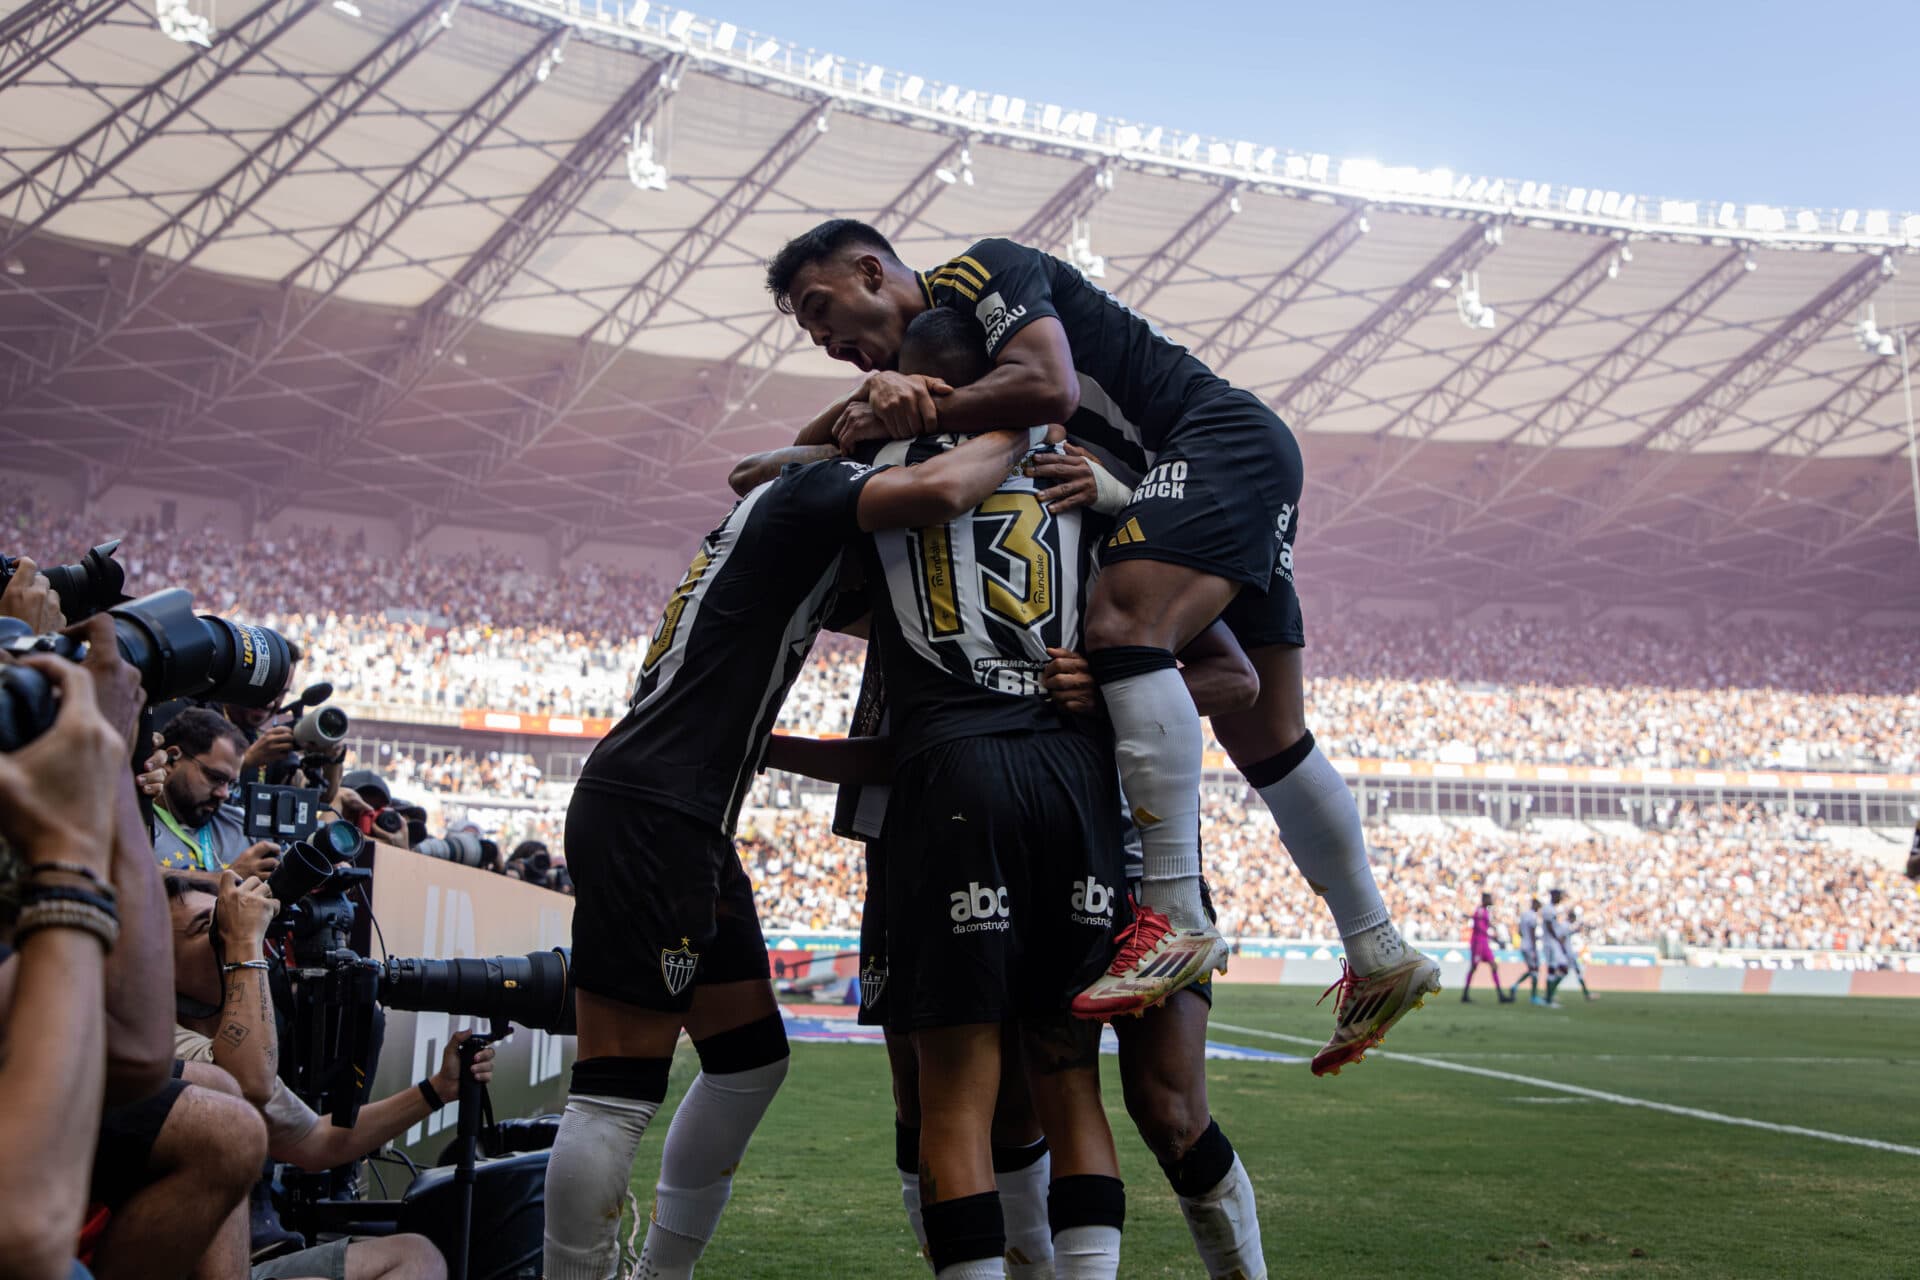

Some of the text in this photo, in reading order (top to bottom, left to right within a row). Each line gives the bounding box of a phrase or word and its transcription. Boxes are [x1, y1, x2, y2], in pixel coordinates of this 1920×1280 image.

[985, 304, 1028, 357] ERDAU
[1141, 460, 1188, 487] UTO
[1126, 481, 1186, 506] RUCK
[1033, 554, 1046, 604] mundiale
[950, 881, 1010, 922] abc
[953, 924, 965, 934] da
[668, 955, 693, 966] CAM
